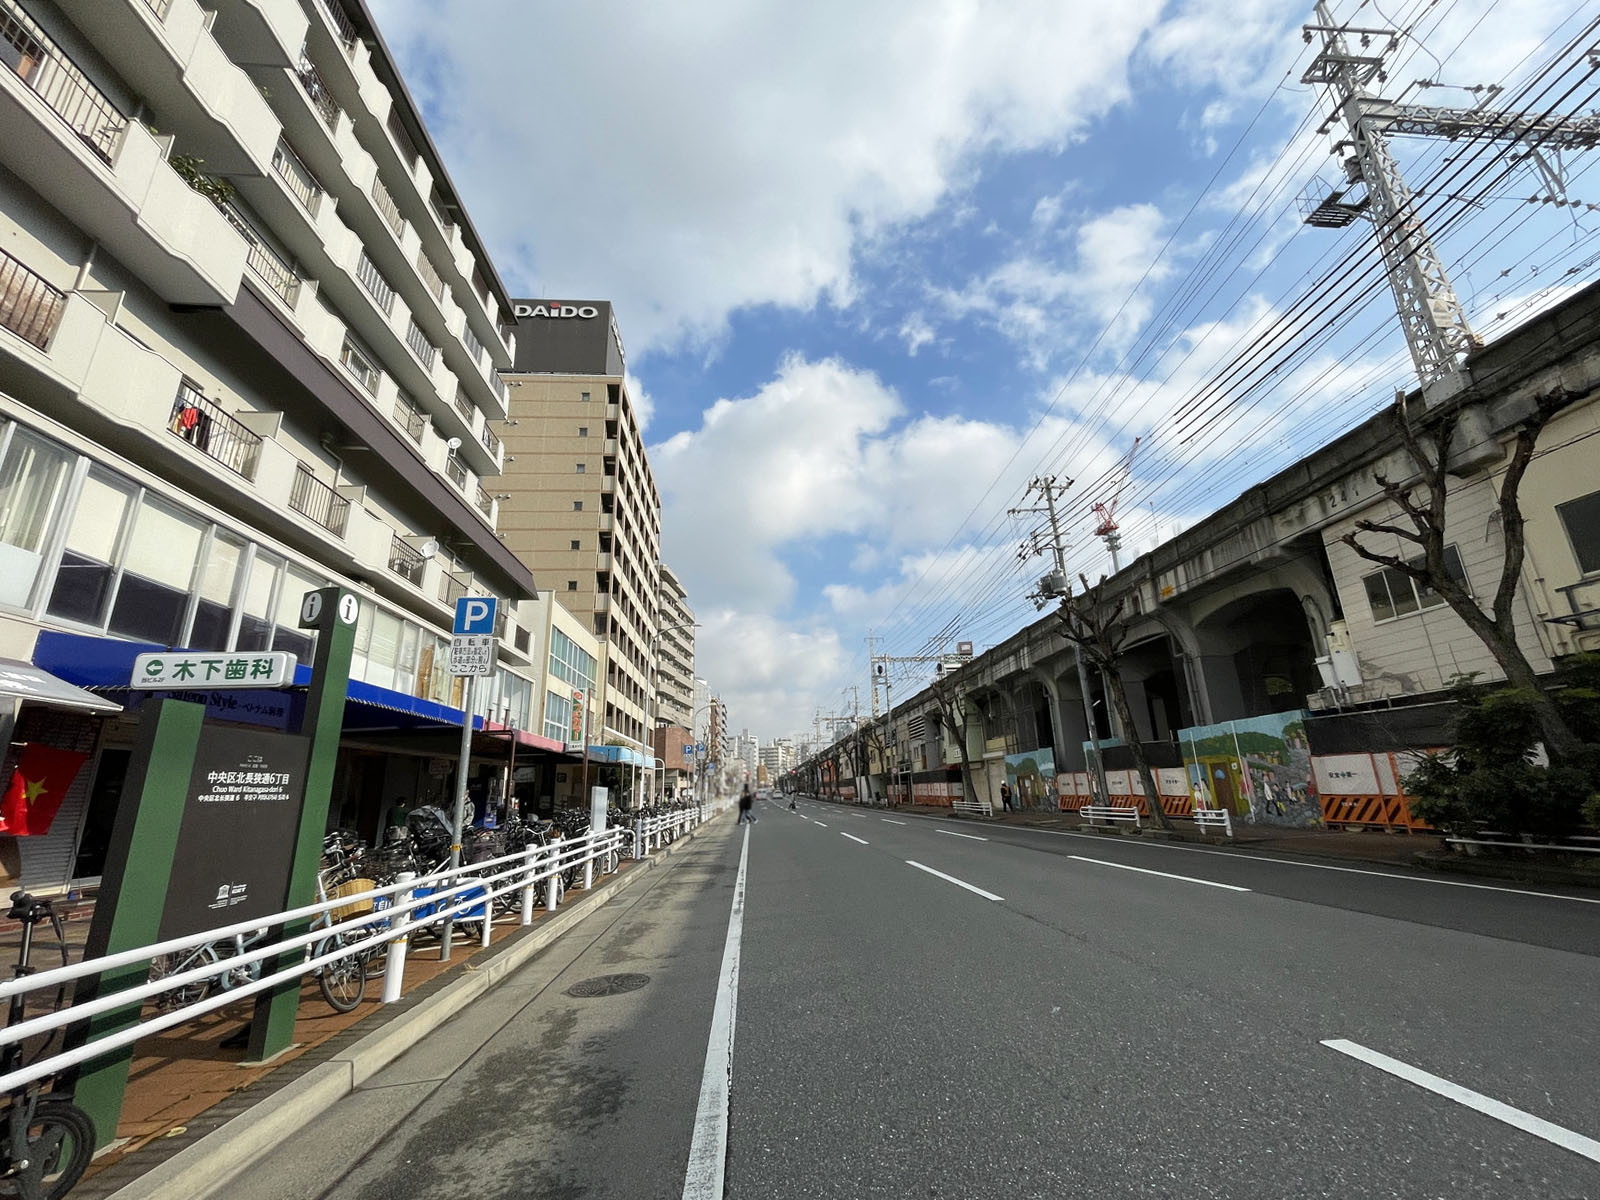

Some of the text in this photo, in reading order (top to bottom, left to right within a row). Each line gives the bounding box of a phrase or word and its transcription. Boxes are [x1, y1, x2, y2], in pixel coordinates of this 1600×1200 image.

[464, 601, 488, 631] P
[172, 658, 273, 681] 木下歯科
[450, 664, 487, 673] ここから
[208, 770, 290, 785] 中央区北長狭通6丁目
[212, 785, 227, 793] Chuo
